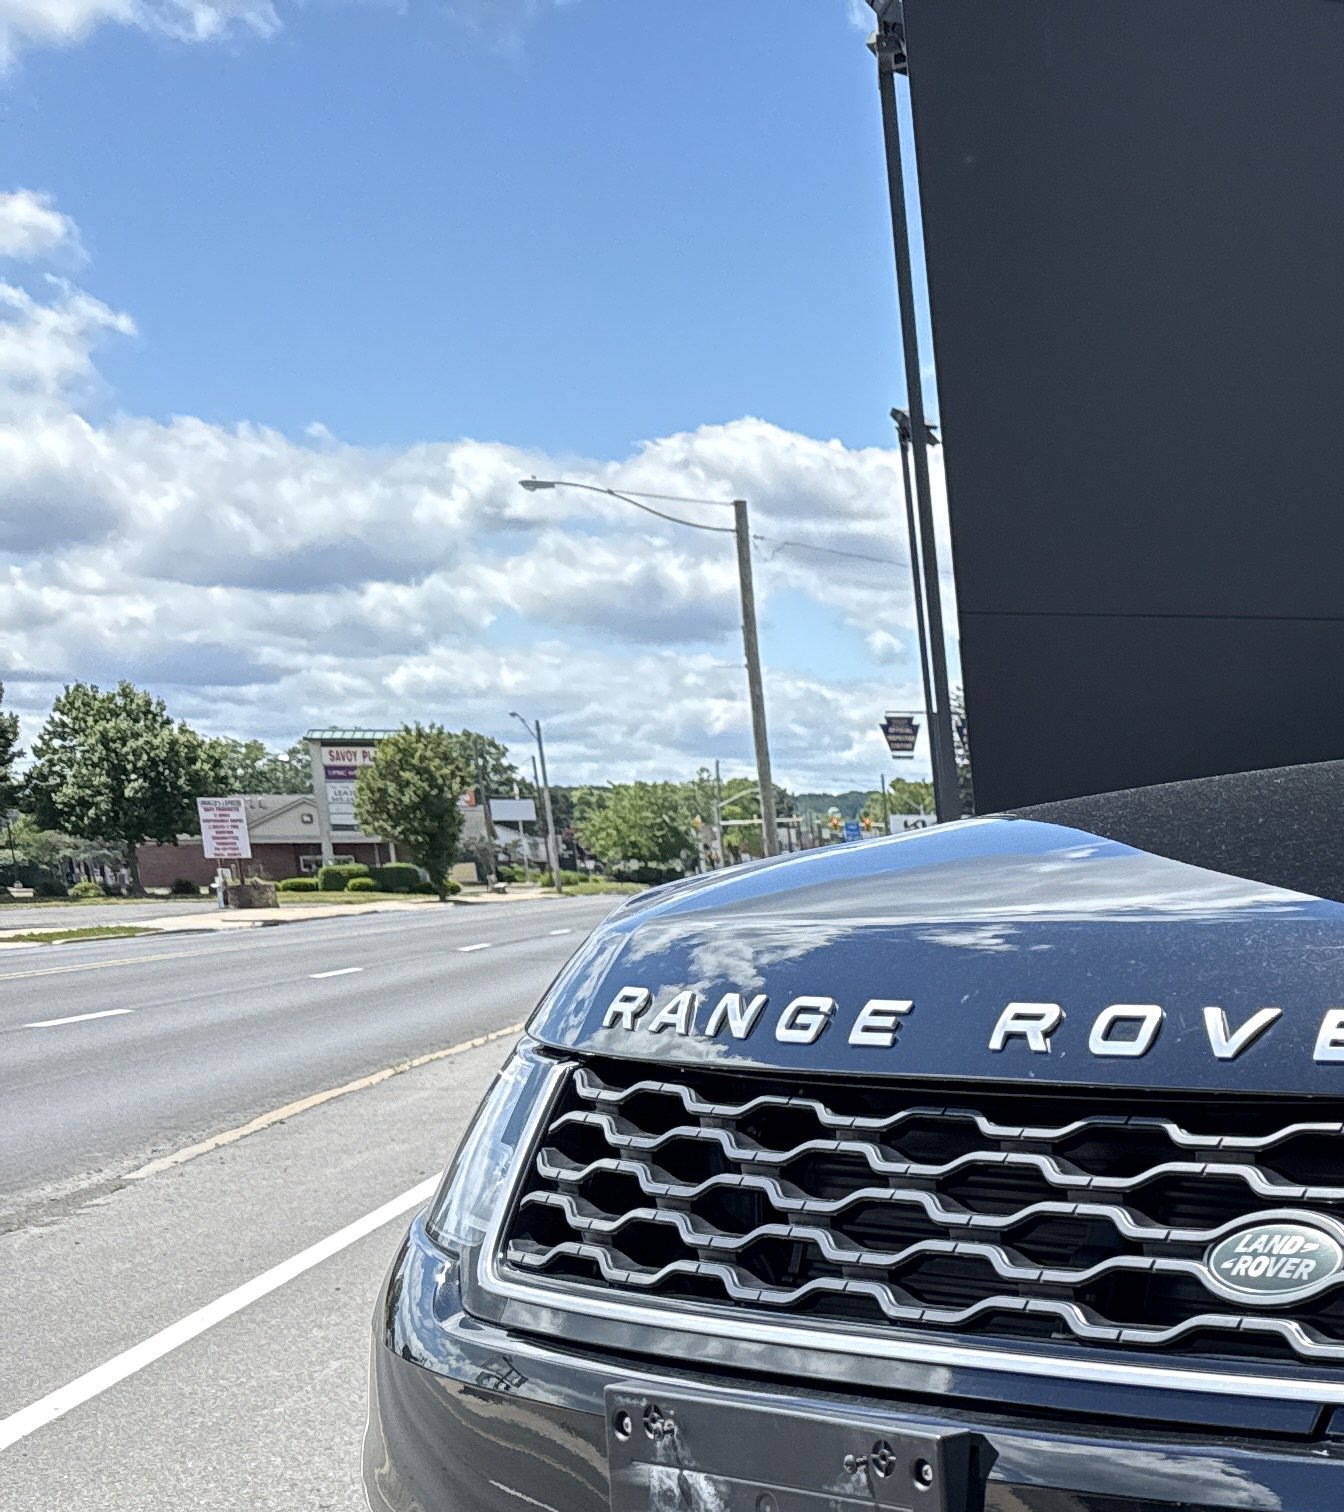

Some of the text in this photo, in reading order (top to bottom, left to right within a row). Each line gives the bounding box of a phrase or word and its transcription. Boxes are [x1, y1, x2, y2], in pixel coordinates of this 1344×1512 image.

[329, 749, 358, 762] SAVOY
[602, 984, 915, 1049] RANGE
[1234, 1234, 1305, 1255] LAND
[1230, 1255, 1317, 1281] ROVER
